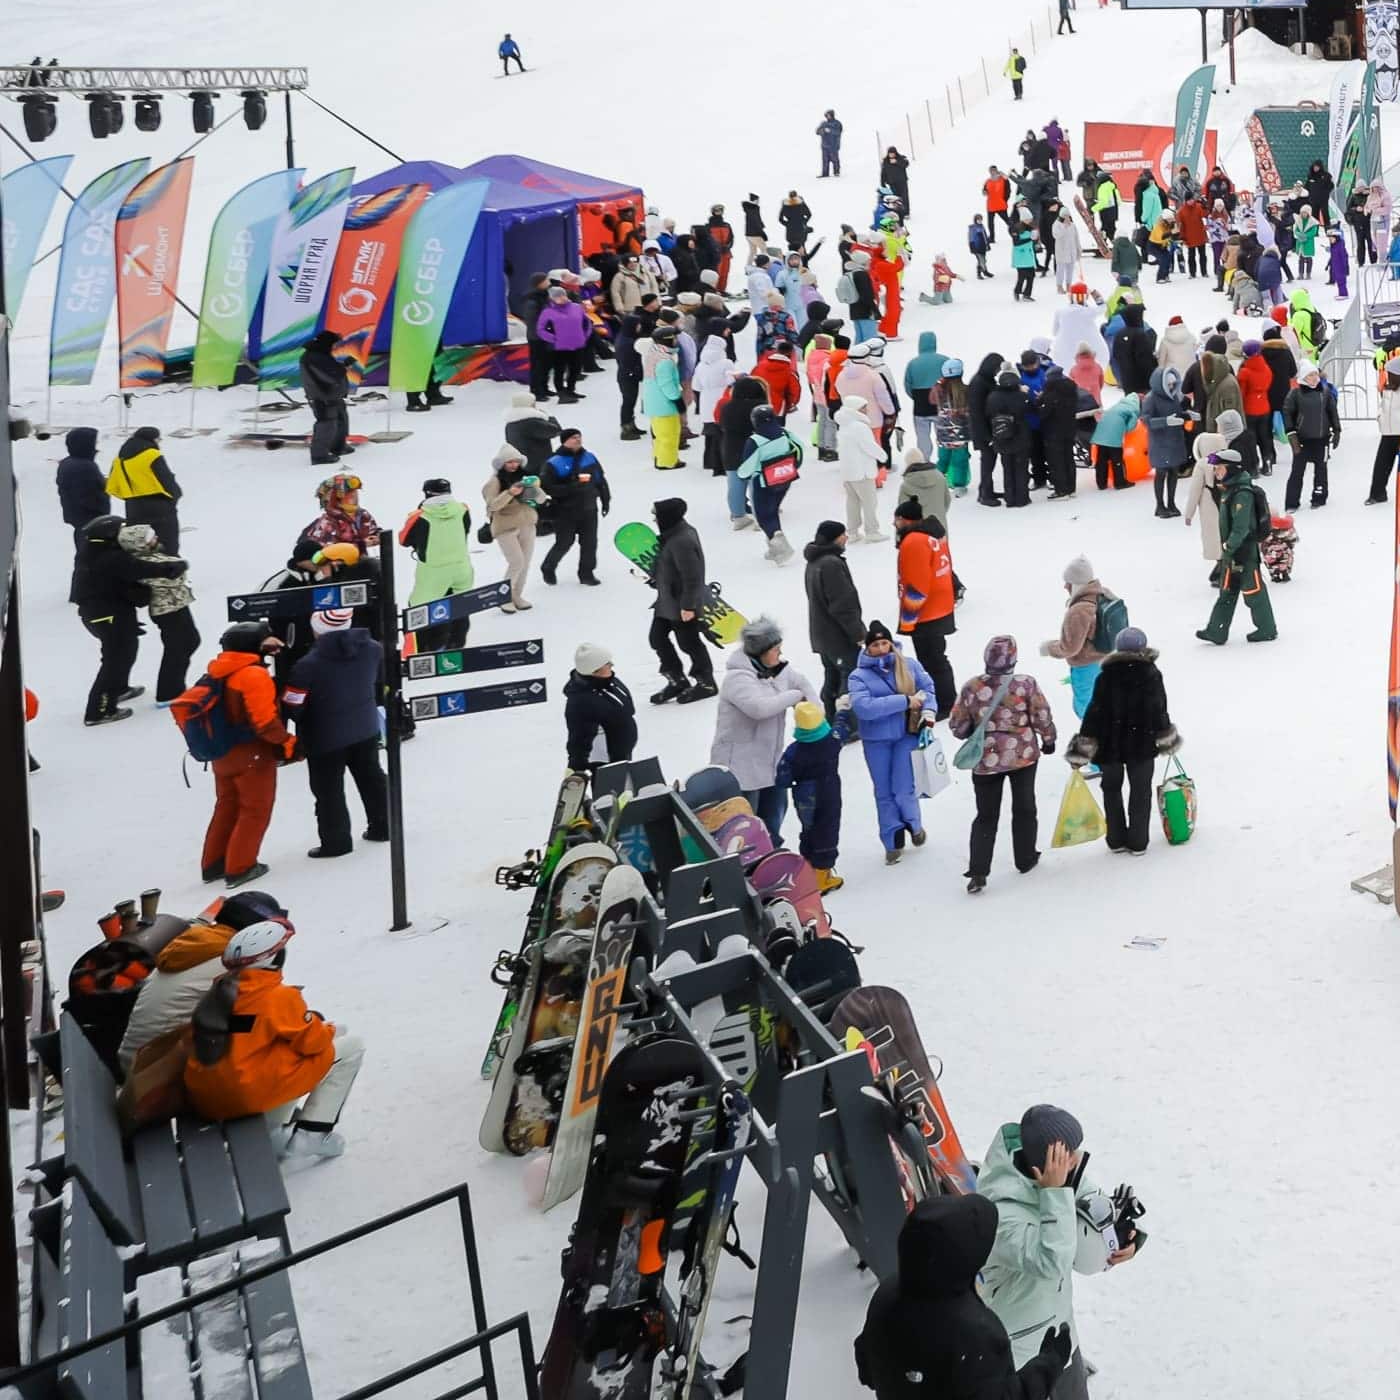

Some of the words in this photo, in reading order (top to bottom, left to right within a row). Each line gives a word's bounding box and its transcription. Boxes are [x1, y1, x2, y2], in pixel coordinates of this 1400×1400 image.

[223, 228, 256, 287] СБЕР
[305, 238, 329, 266] ГРАД
[352, 240, 377, 285] УГМК
[415, 237, 447, 295] СБЕР
[294, 267, 317, 304] ШОРИЯ
[580, 980, 616, 1104] GNU
